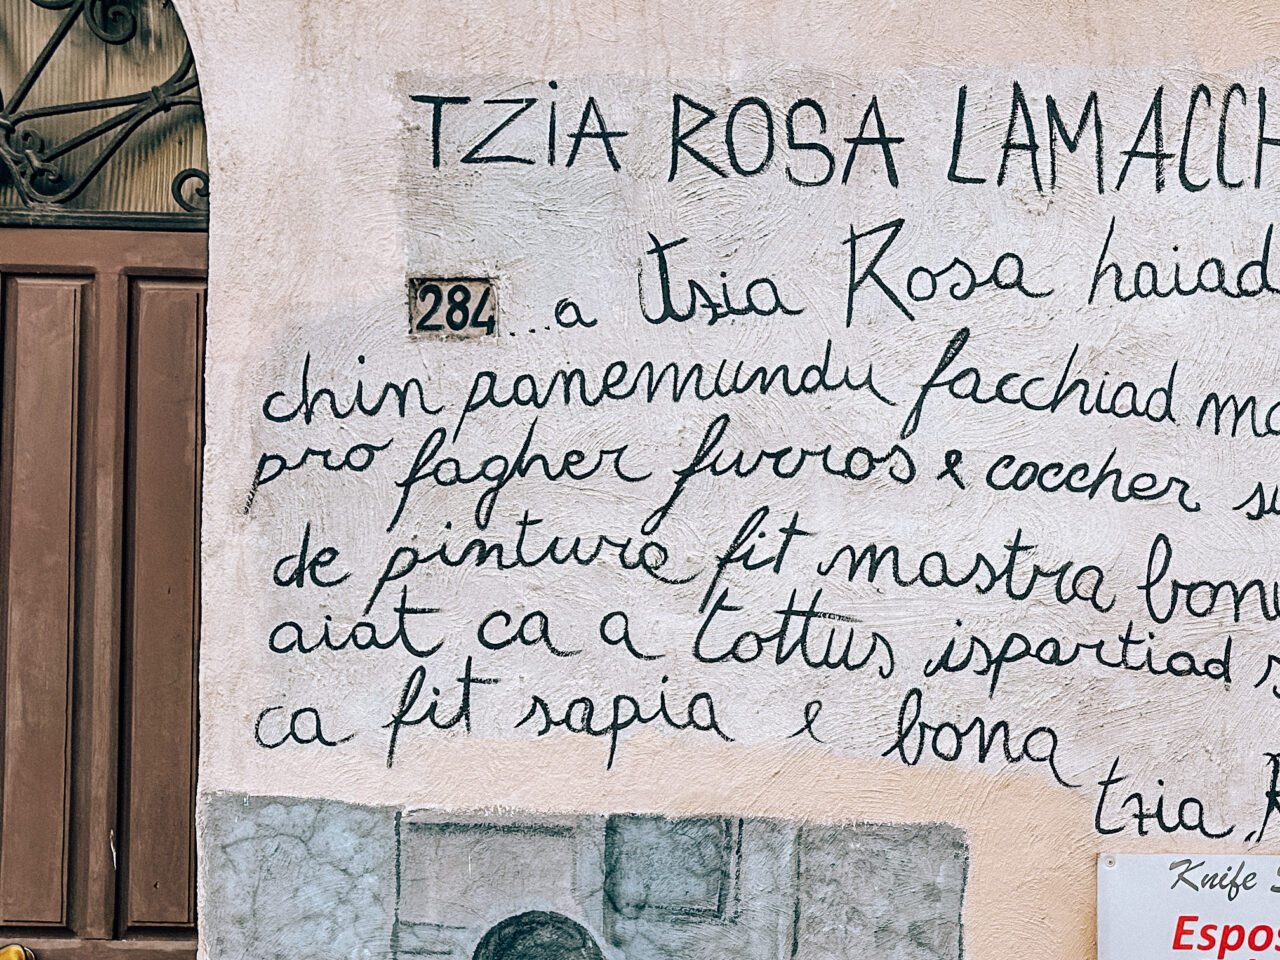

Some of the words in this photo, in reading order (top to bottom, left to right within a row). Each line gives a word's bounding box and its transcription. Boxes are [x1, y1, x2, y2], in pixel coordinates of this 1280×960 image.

[667, 92, 905, 188] ROSA
[416, 284, 496, 335] 284
[841, 217, 1054, 328] Rosa
[262, 350, 443, 424] chin
[452, 339, 897, 442] panemundu
[901, 327, 1180, 439] facchiad
[244, 437, 394, 515] pro
[387, 417, 652, 532] fagher
[986, 447, 1201, 513] coccher
[273, 522, 350, 588] de
[700, 505, 816, 613] fit
[817, 528, 1116, 613] mastra
[268, 585, 445, 658] aiat
[477, 609, 582, 657] ca
[600, 610, 665, 660] a
[692, 587, 895, 679] tottus
[924, 619, 1233, 699] ispartiad
[254, 705, 356, 749] ca
[380, 656, 500, 769] fit
[514, 675, 735, 771] sapia
[787, 700, 824, 743] e
[881, 688, 1081, 788] bona
[1169, 858, 1257, 901] Knife
